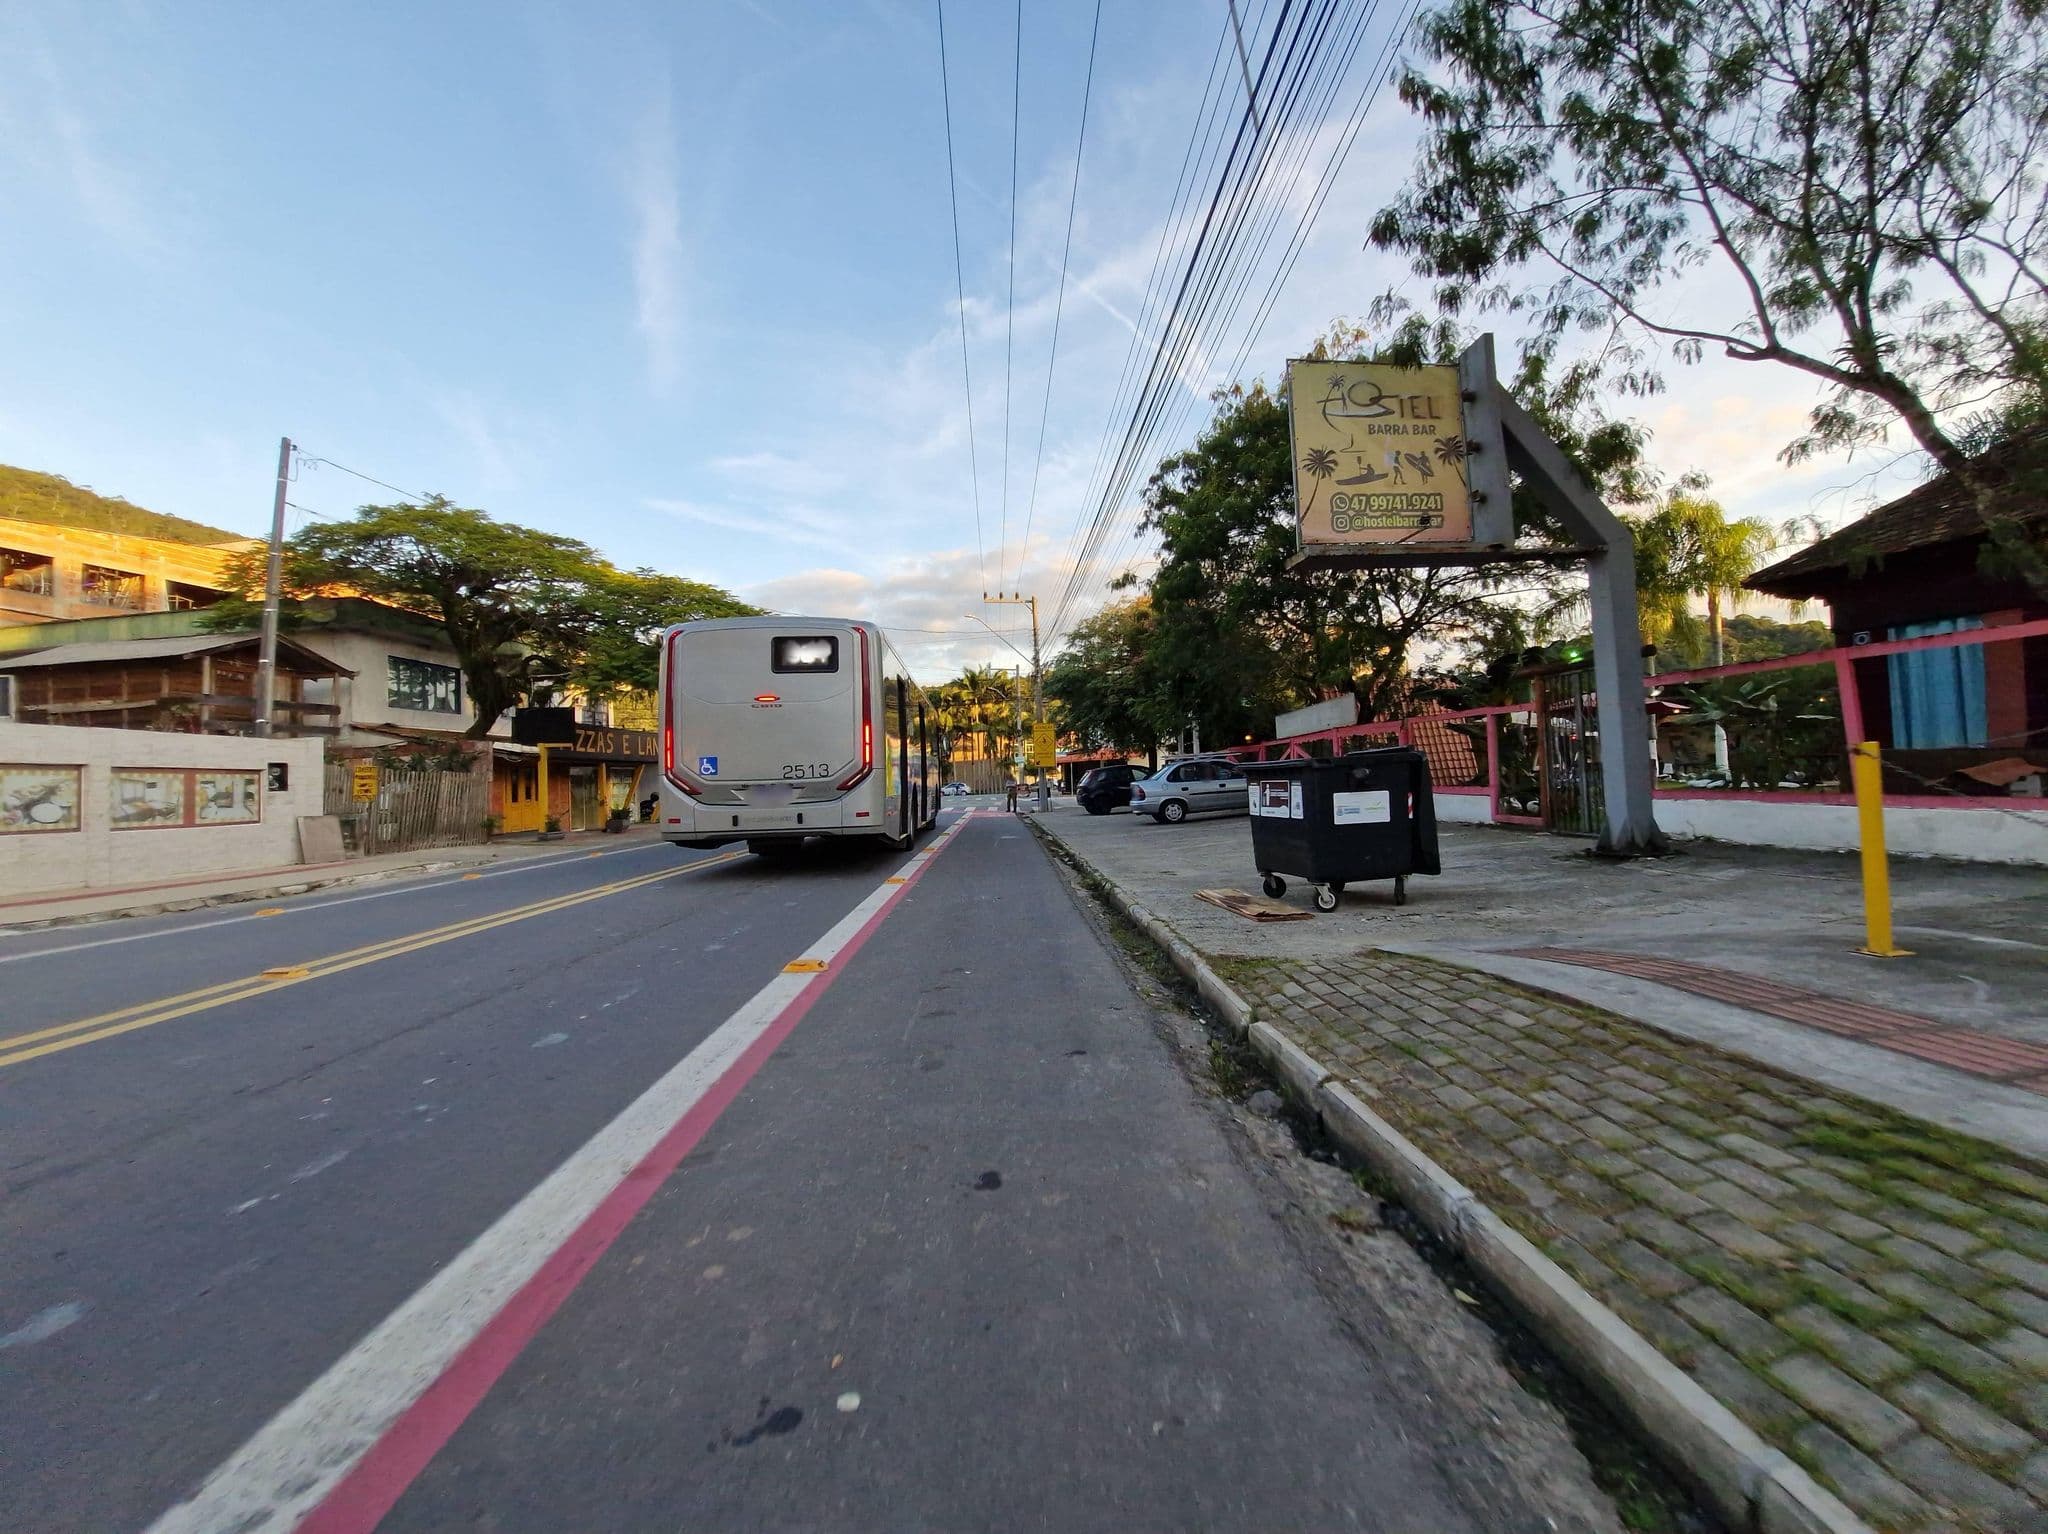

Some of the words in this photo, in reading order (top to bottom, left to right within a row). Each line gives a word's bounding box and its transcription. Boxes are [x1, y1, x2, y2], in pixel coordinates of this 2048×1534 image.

[1368, 424, 1408, 435] BARRA
[1412, 424, 1436, 435] BAR
[1351, 495, 1367, 510] 47
[1370, 494, 1441, 510] 99741.9241
[1354, 515, 1442, 528] @hostelbarrar
[622, 734, 631, 755] E
[782, 763, 830, 779] 2513
